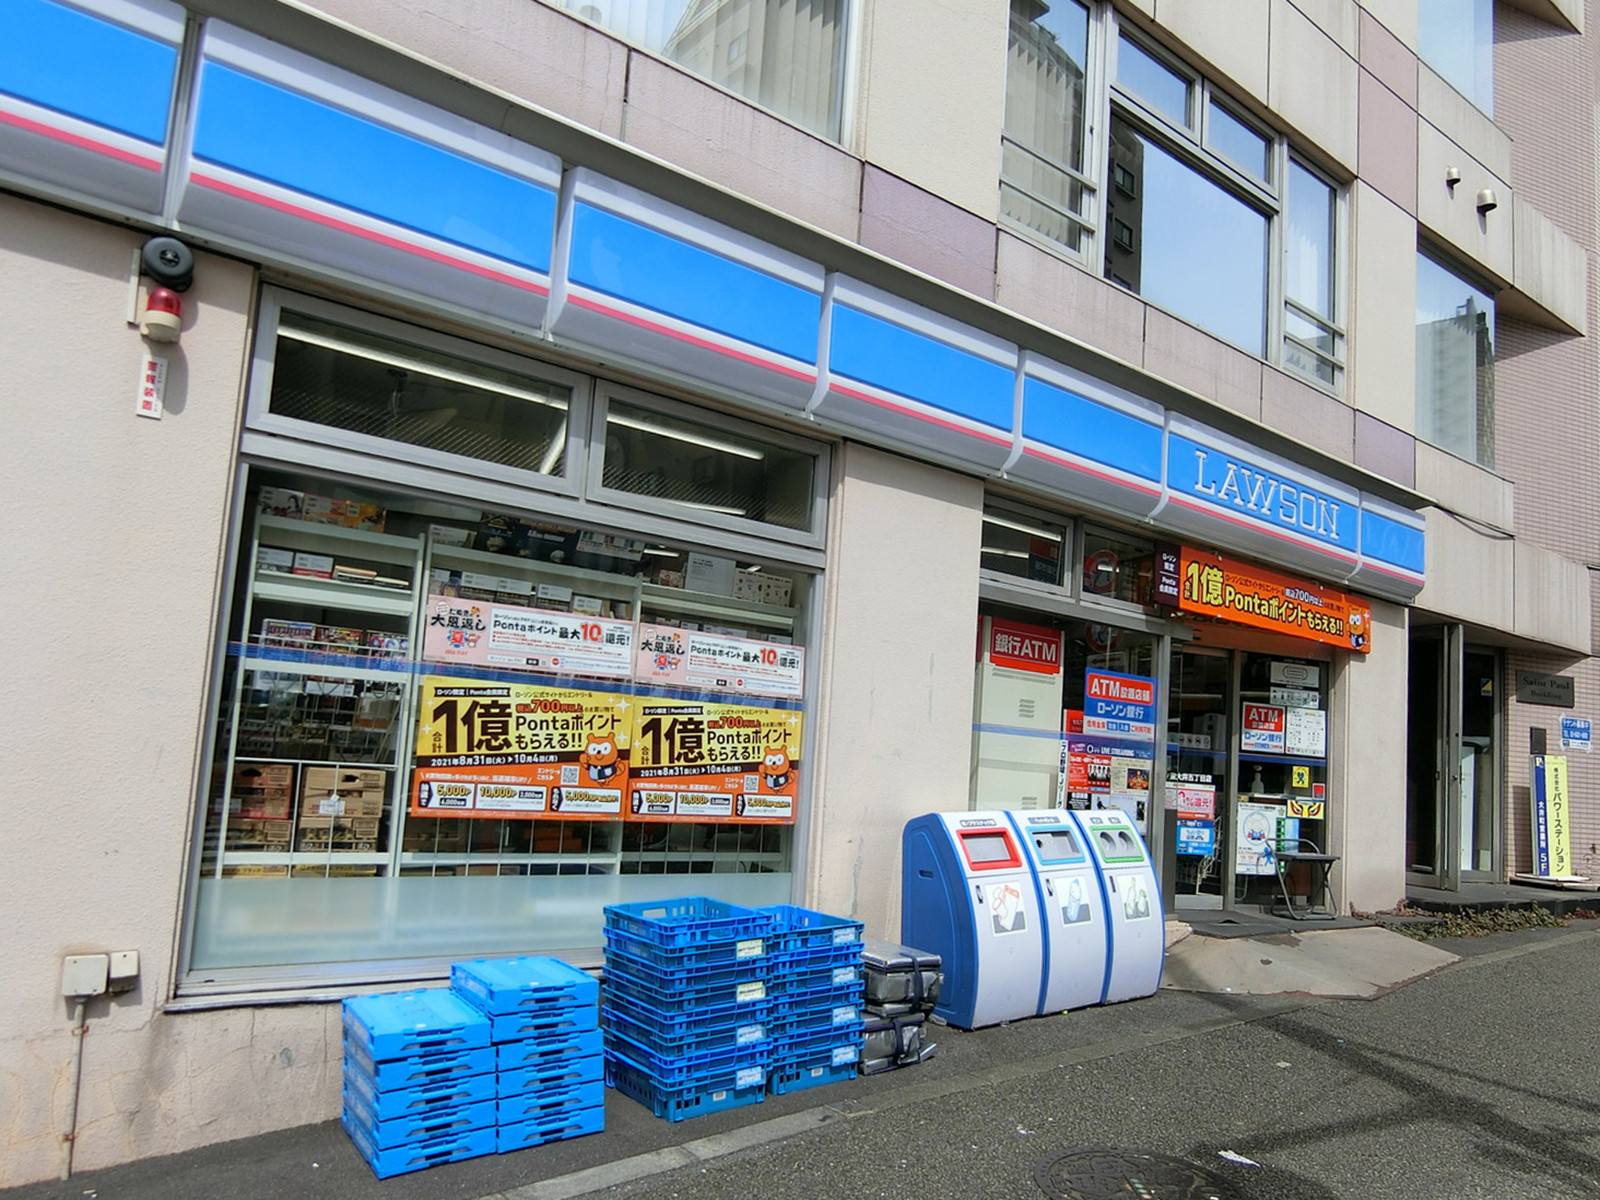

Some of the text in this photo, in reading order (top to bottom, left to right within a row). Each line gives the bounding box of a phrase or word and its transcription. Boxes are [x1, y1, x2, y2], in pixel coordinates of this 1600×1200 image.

[1194, 450, 1340, 540] LAWSON
[1187, 562, 1224, 606] 1億
[431, 614, 487, 631] 大恩返し
[641, 640, 686, 655] 大恩返し
[995, 633, 1056, 661] 銀行ATM
[1091, 678, 1150, 702] ATM設置店舗
[1522, 676, 1570, 690] Saint Paul
[1097, 702, 1144, 719] ローソン銀行
[1249, 707, 1278, 722] ATM
[432, 699, 513, 754] 1億
[515, 714, 622, 731] Pontaポイント
[432, 732, 443, 753] 合計
[515, 733, 582, 750] もらえる!!
[641, 718, 706, 765] 1億
[707, 729, 792, 745] Pontaポイント
[1245, 731, 1282, 743] ローソン銀行
[707, 746, 761, 762] もらえる!!
